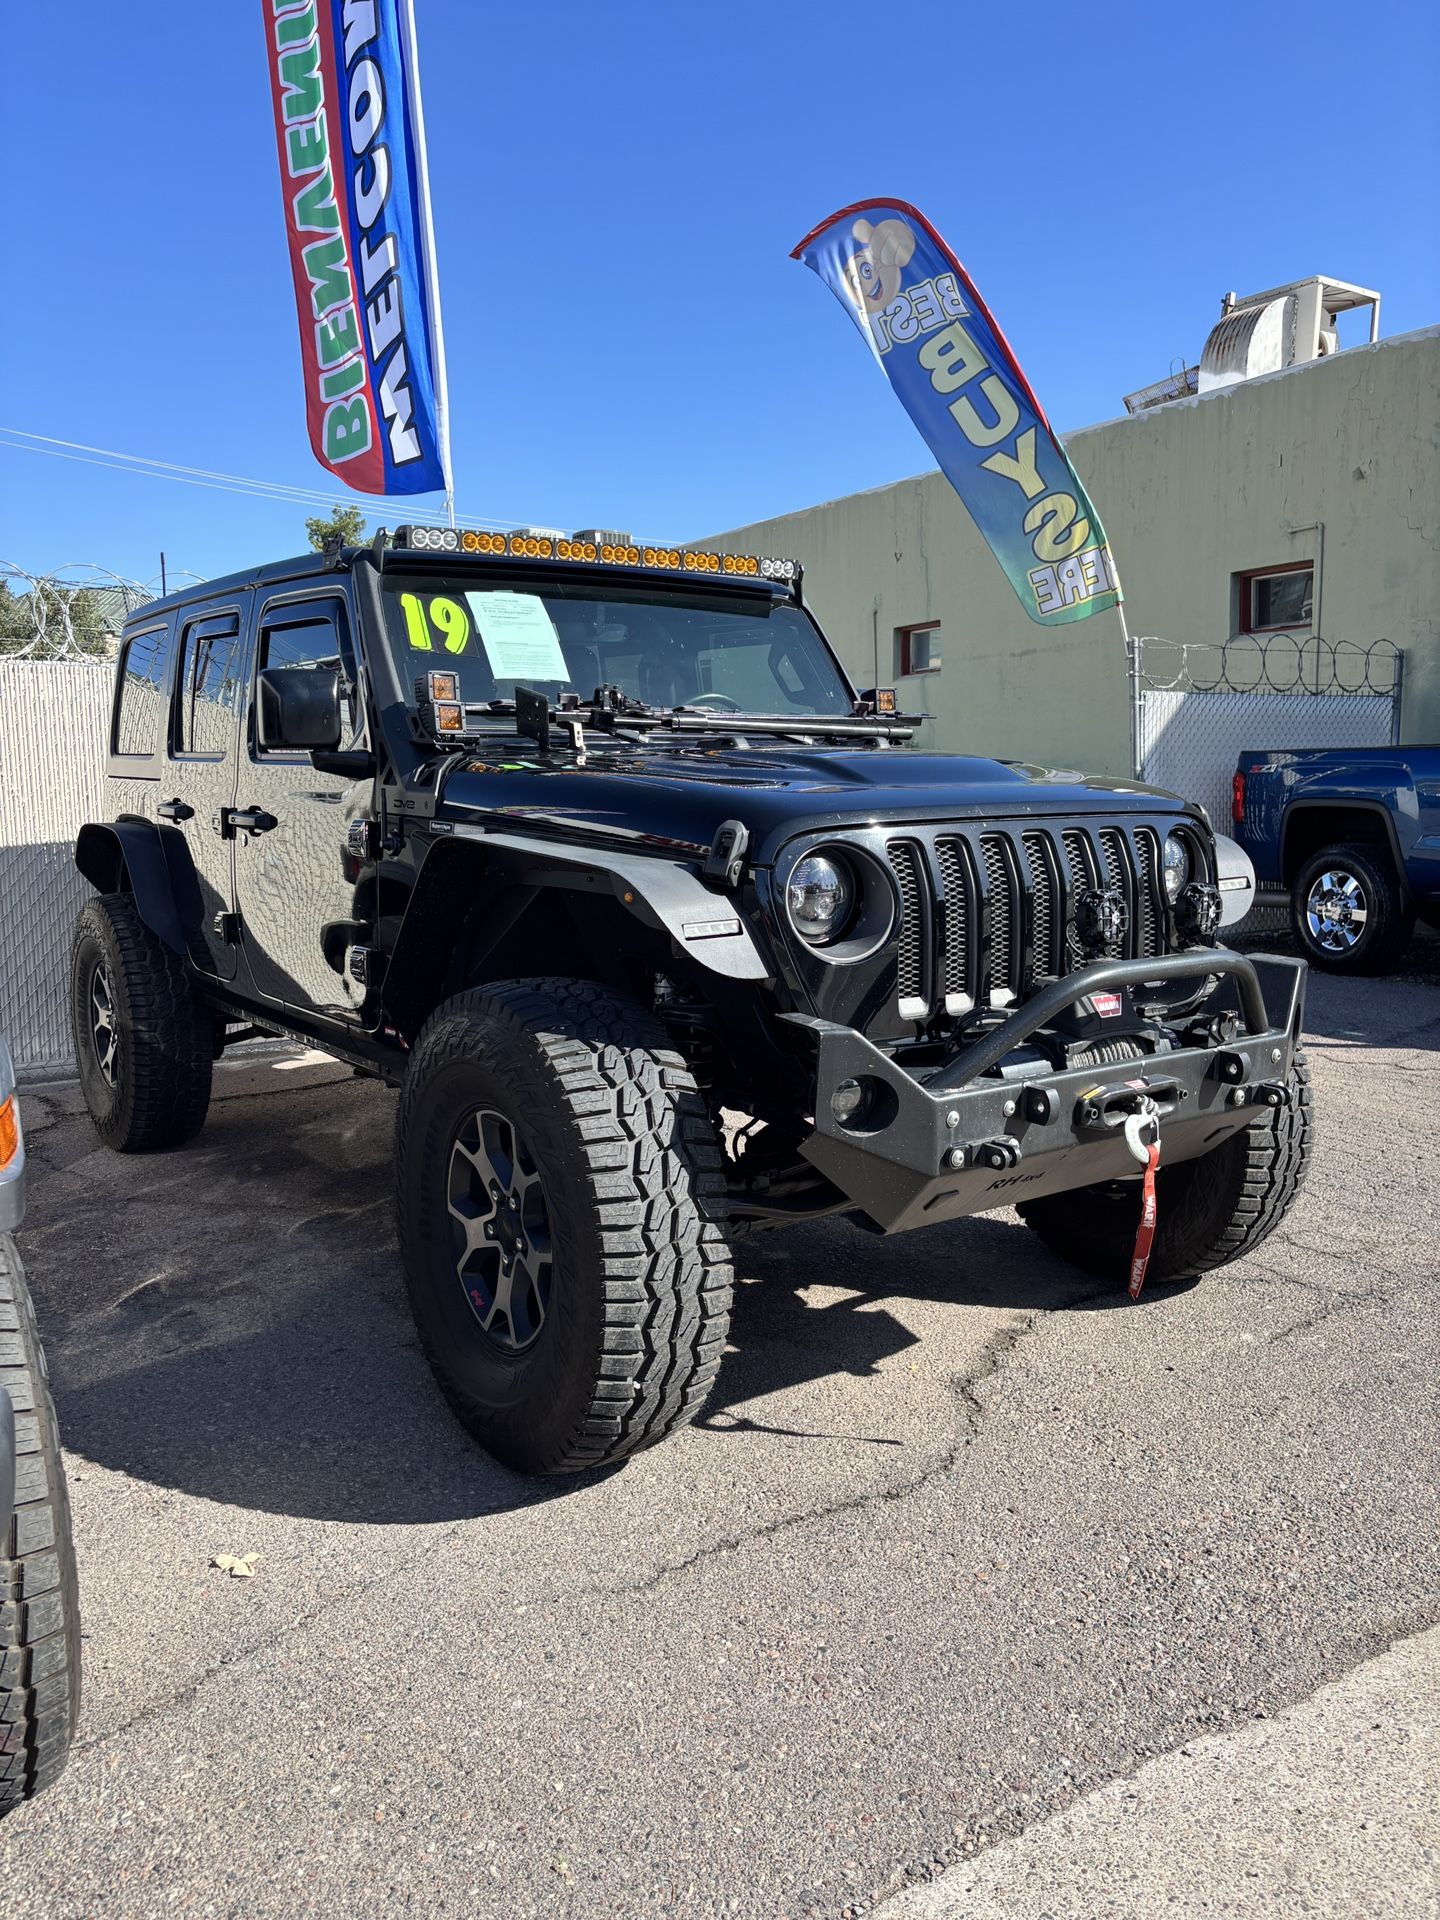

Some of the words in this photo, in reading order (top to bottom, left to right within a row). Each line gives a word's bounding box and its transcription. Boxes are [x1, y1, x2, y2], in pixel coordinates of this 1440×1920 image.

[401, 593, 470, 655] 19
[1144, 1194, 1156, 1229] WARN
[1129, 1257, 1145, 1291] WARN
